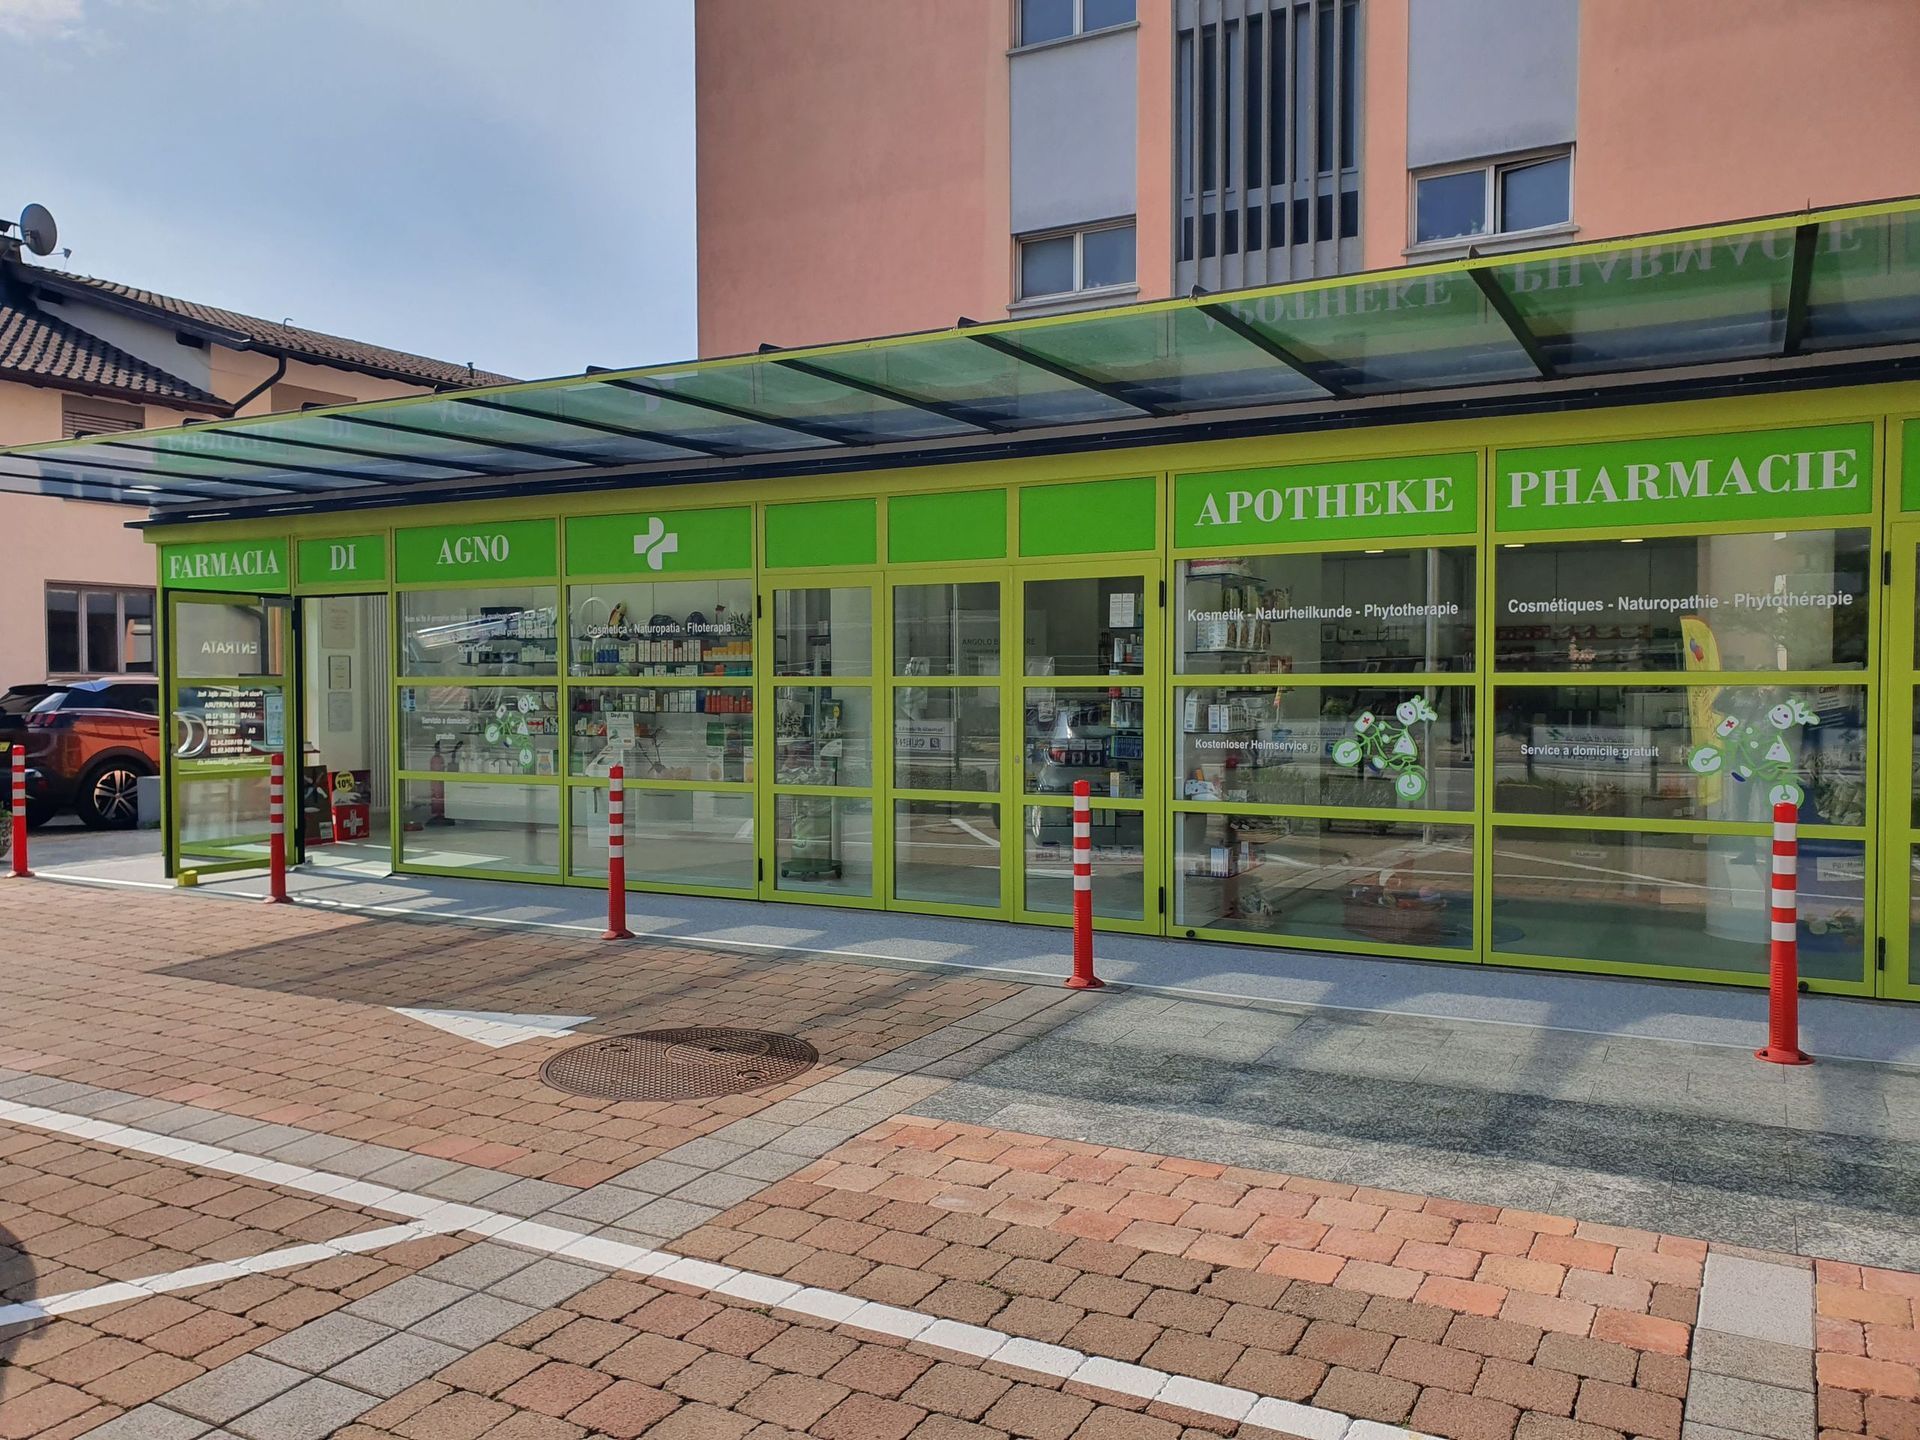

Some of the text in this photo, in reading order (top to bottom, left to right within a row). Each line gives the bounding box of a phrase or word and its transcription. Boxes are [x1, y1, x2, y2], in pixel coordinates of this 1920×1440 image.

[1507, 449, 1858, 508] PHARMACIE
[1194, 476, 1454, 526] APOTHEKE
[329, 544, 357, 571] DI
[436, 534, 510, 565] AGNO
[169, 549, 280, 579] FARMACIA
[1187, 608, 1244, 621] Kosmetik
[1255, 604, 1352, 620] Naturheilkunde
[1364, 601, 1459, 620] Phytotherapie
[1507, 597, 1604, 615] Cosmétiques
[1618, 594, 1719, 613] Naturopathie
[1734, 589, 1854, 610] Phytothérapie
[587, 624, 628, 634] Cosmetica
[633, 623, 680, 637] Naturopatia
[687, 622, 731, 635] Fitoterapia
[1195, 738, 1249, 750] Kostenloser
[1520, 744, 1560, 756] Service
[1572, 744, 1619, 756] domicile
[1621, 745, 1659, 759] gratuit
